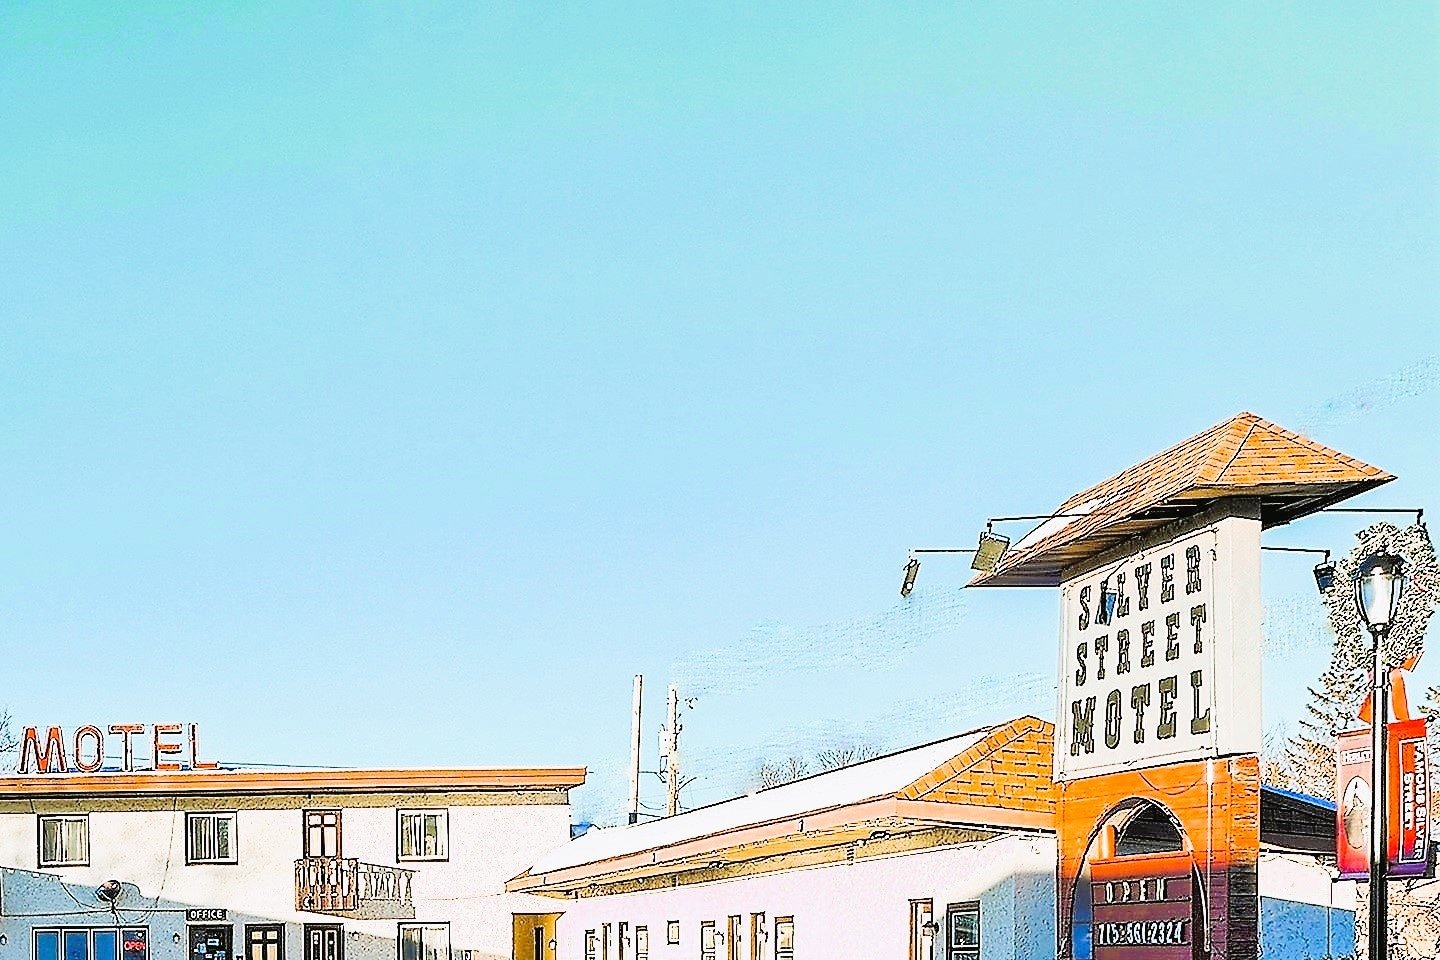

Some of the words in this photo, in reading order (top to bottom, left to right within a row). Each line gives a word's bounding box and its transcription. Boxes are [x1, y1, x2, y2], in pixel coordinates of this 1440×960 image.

[1076, 603, 1207, 687] STREET
[1070, 669, 1211, 757] MOTEL
[16, 722, 220, 775] MOTEL
[1414, 740, 1426, 805] FAMOUS
[1403, 772, 1414, 831] STREET
[1414, 806, 1426, 860] SILVER
[190, 909, 223, 920] OFFICE
[1105, 879, 1165, 904] OPEN
[124, 941, 146, 951] OPEN
